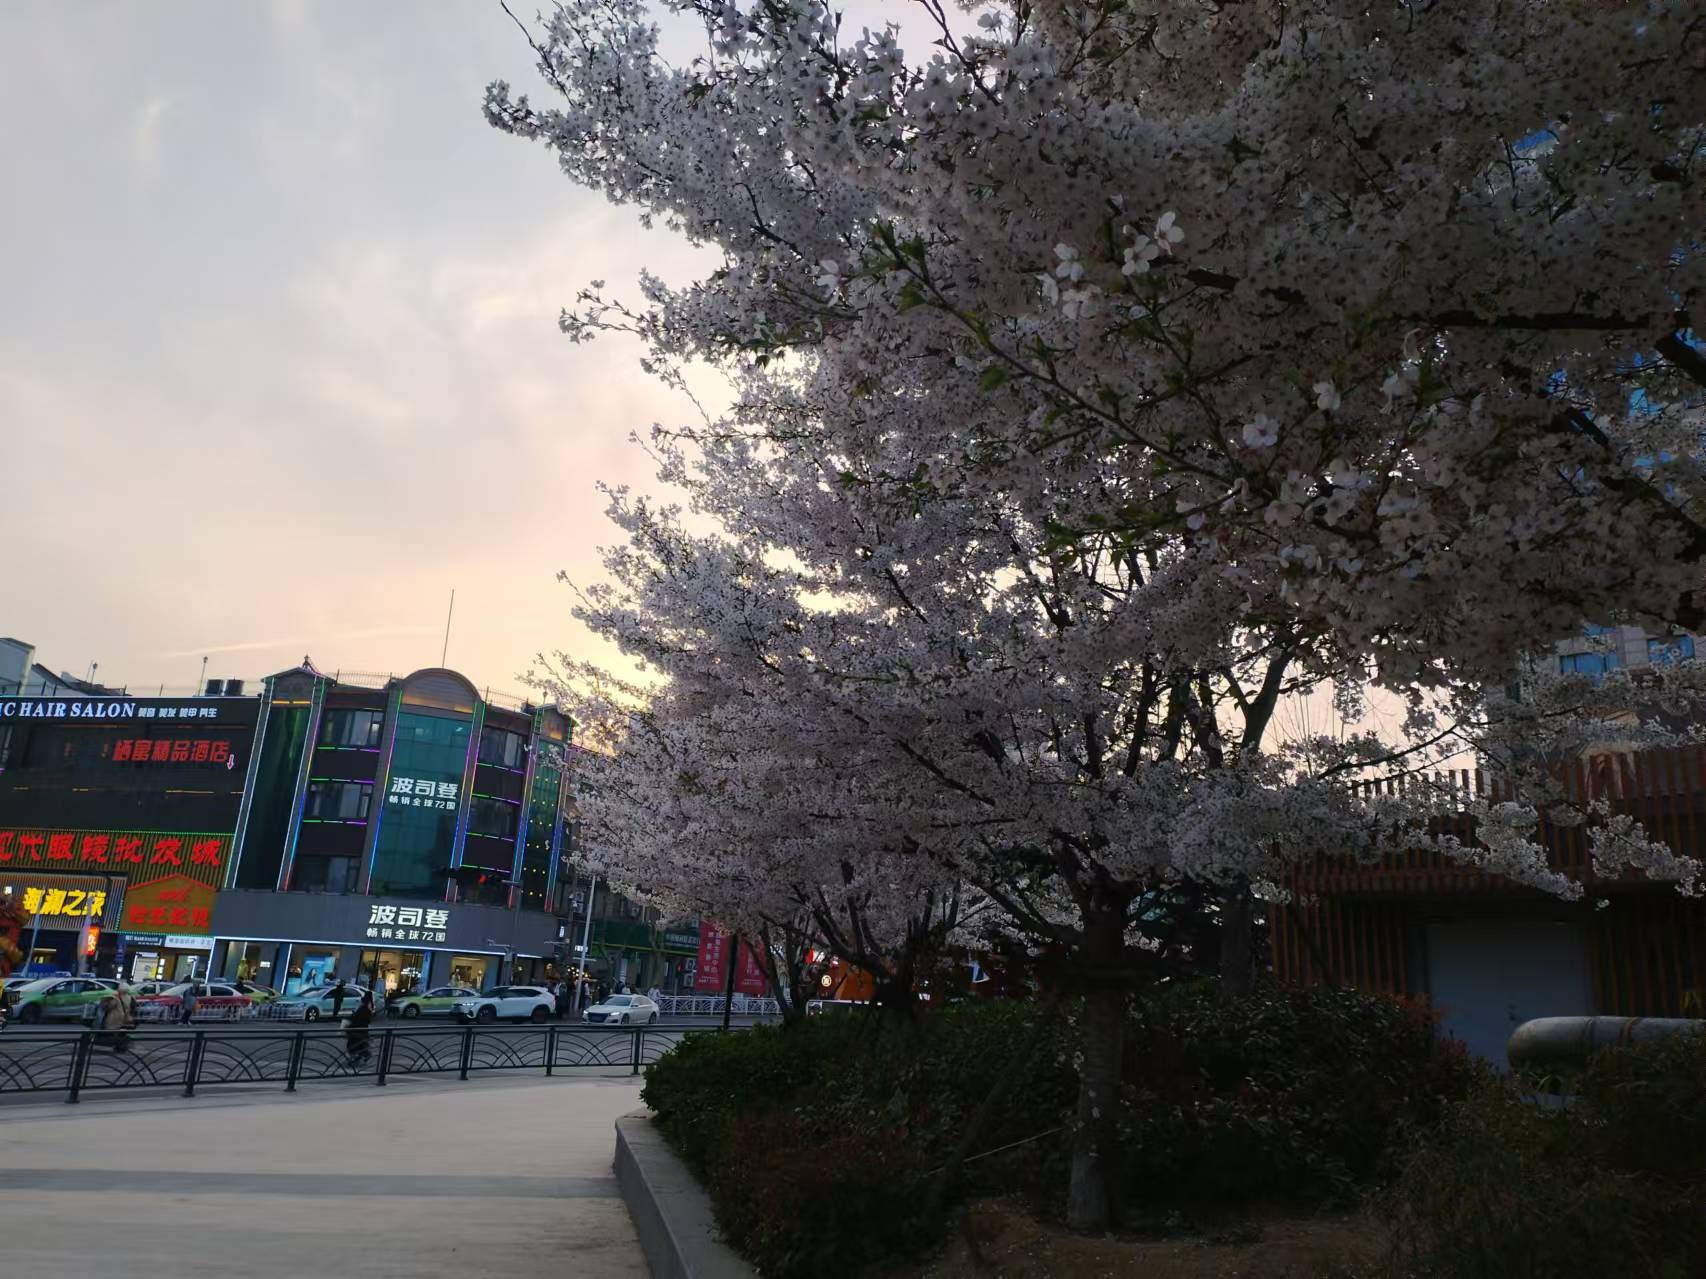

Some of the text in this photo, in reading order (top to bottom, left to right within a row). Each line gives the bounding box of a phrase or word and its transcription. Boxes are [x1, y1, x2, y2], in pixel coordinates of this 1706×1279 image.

[18, 702, 67, 717] HAIR
[70, 703, 136, 718] SALON
[391, 777, 459, 799] 波司登
[369, 905, 449, 928] 波司登
[366, 928, 445, 942] 畅销全球72国
